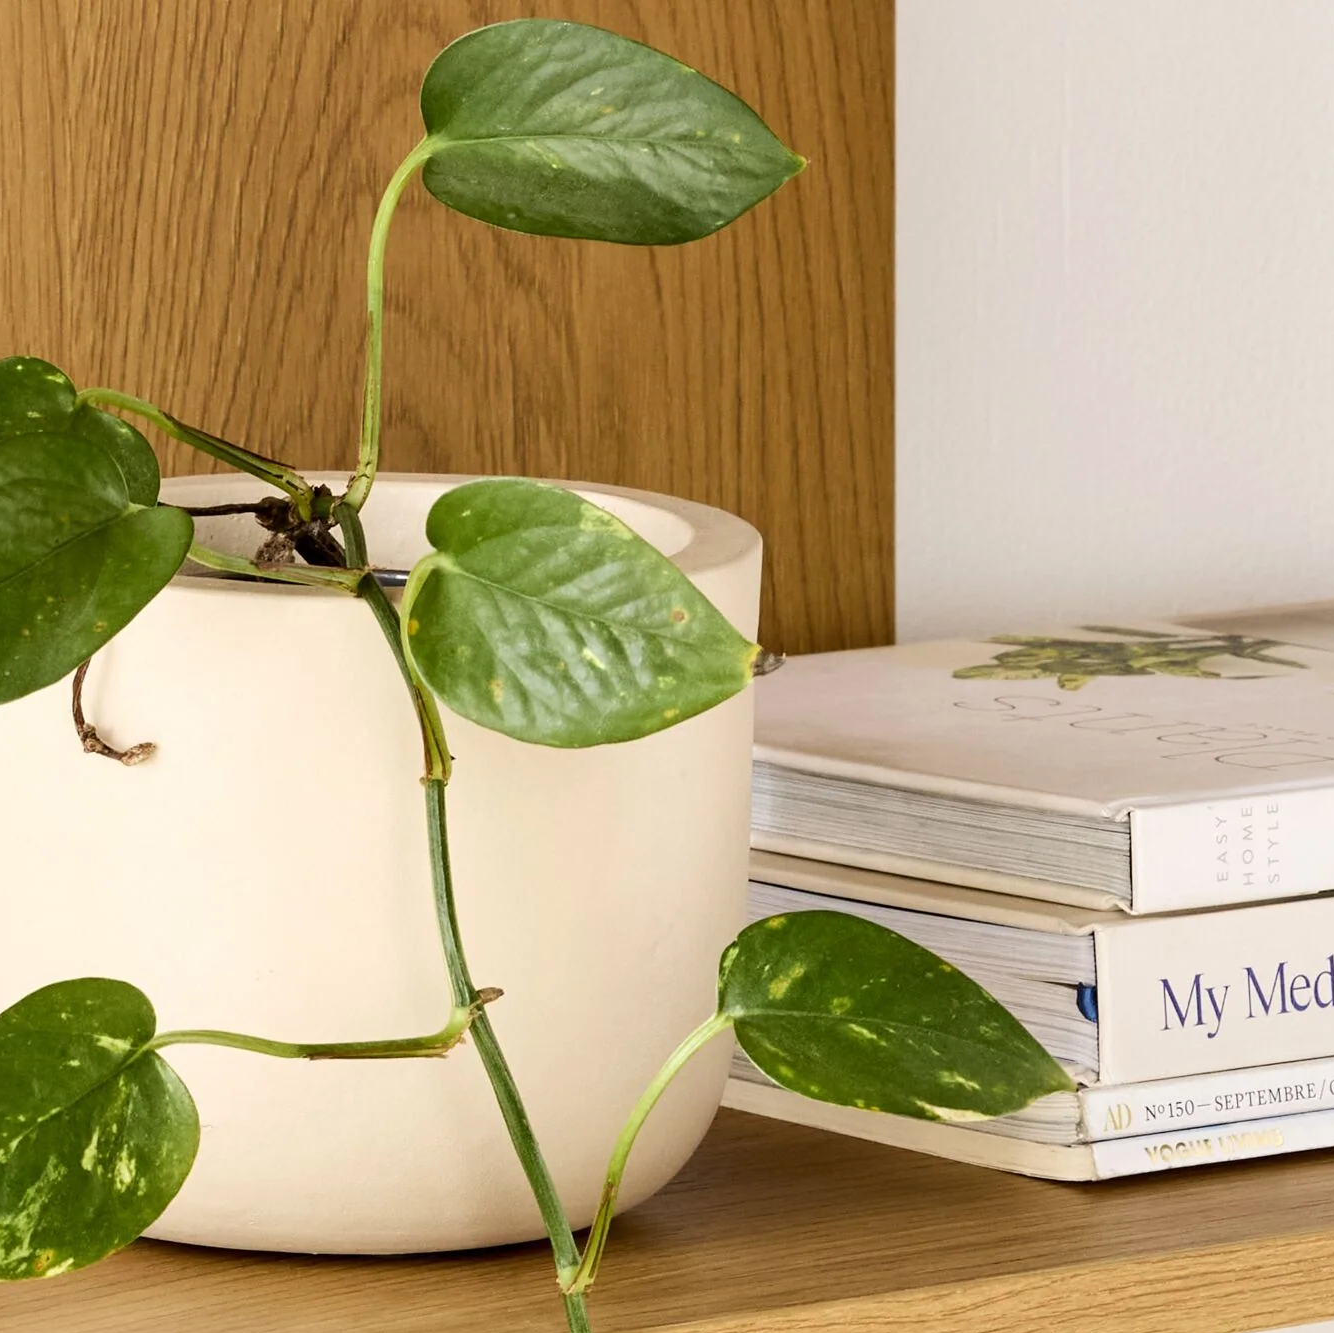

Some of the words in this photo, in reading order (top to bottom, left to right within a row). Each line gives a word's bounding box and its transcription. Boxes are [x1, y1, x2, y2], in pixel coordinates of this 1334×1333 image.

[1215, 816, 1229, 882] EASY
[1241, 806, 1254, 886] HOME
[1267, 803, 1280, 884] STYLE
[1160, 972, 1229, 1039] My
[1104, 1103, 1132, 1132] AD
[1145, 1138, 1212, 1164] VOGUE
